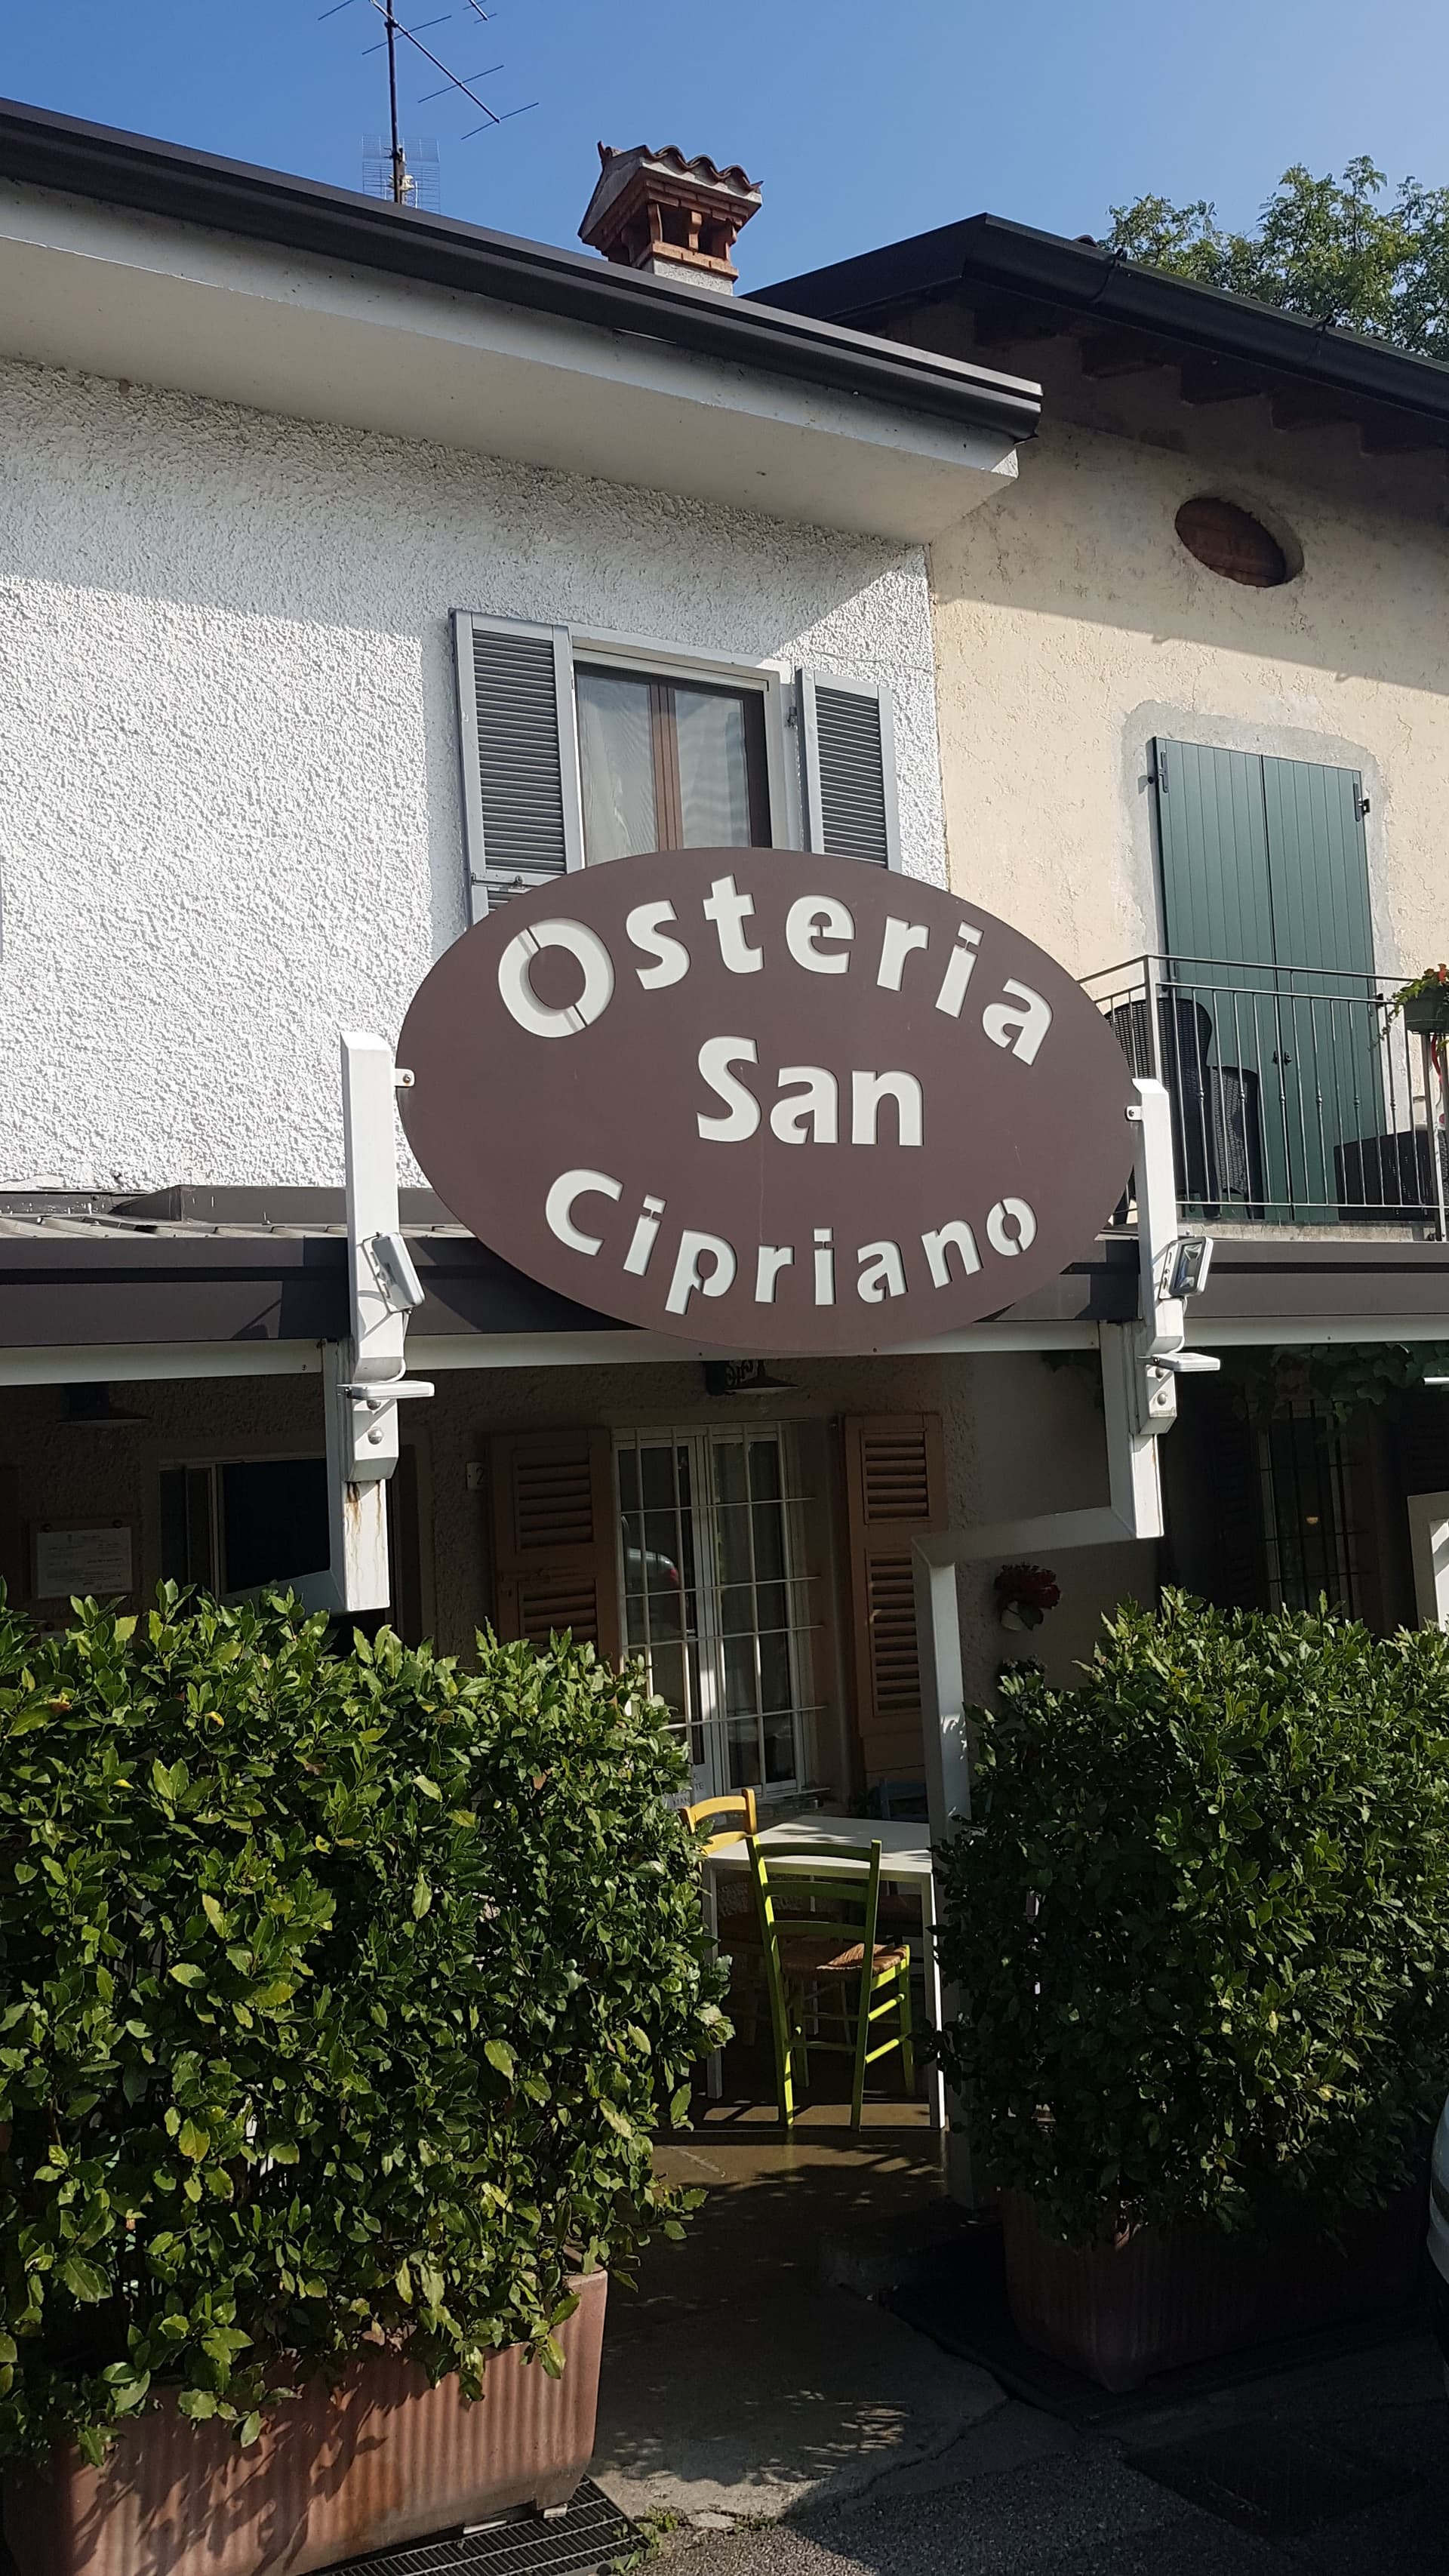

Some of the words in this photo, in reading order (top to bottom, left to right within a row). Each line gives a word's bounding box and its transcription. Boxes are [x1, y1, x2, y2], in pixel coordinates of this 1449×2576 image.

[497, 875, 1054, 1066] Osteria
[697, 1036, 923, 1146] San
[545, 1168, 1038, 1315] Cipriano
